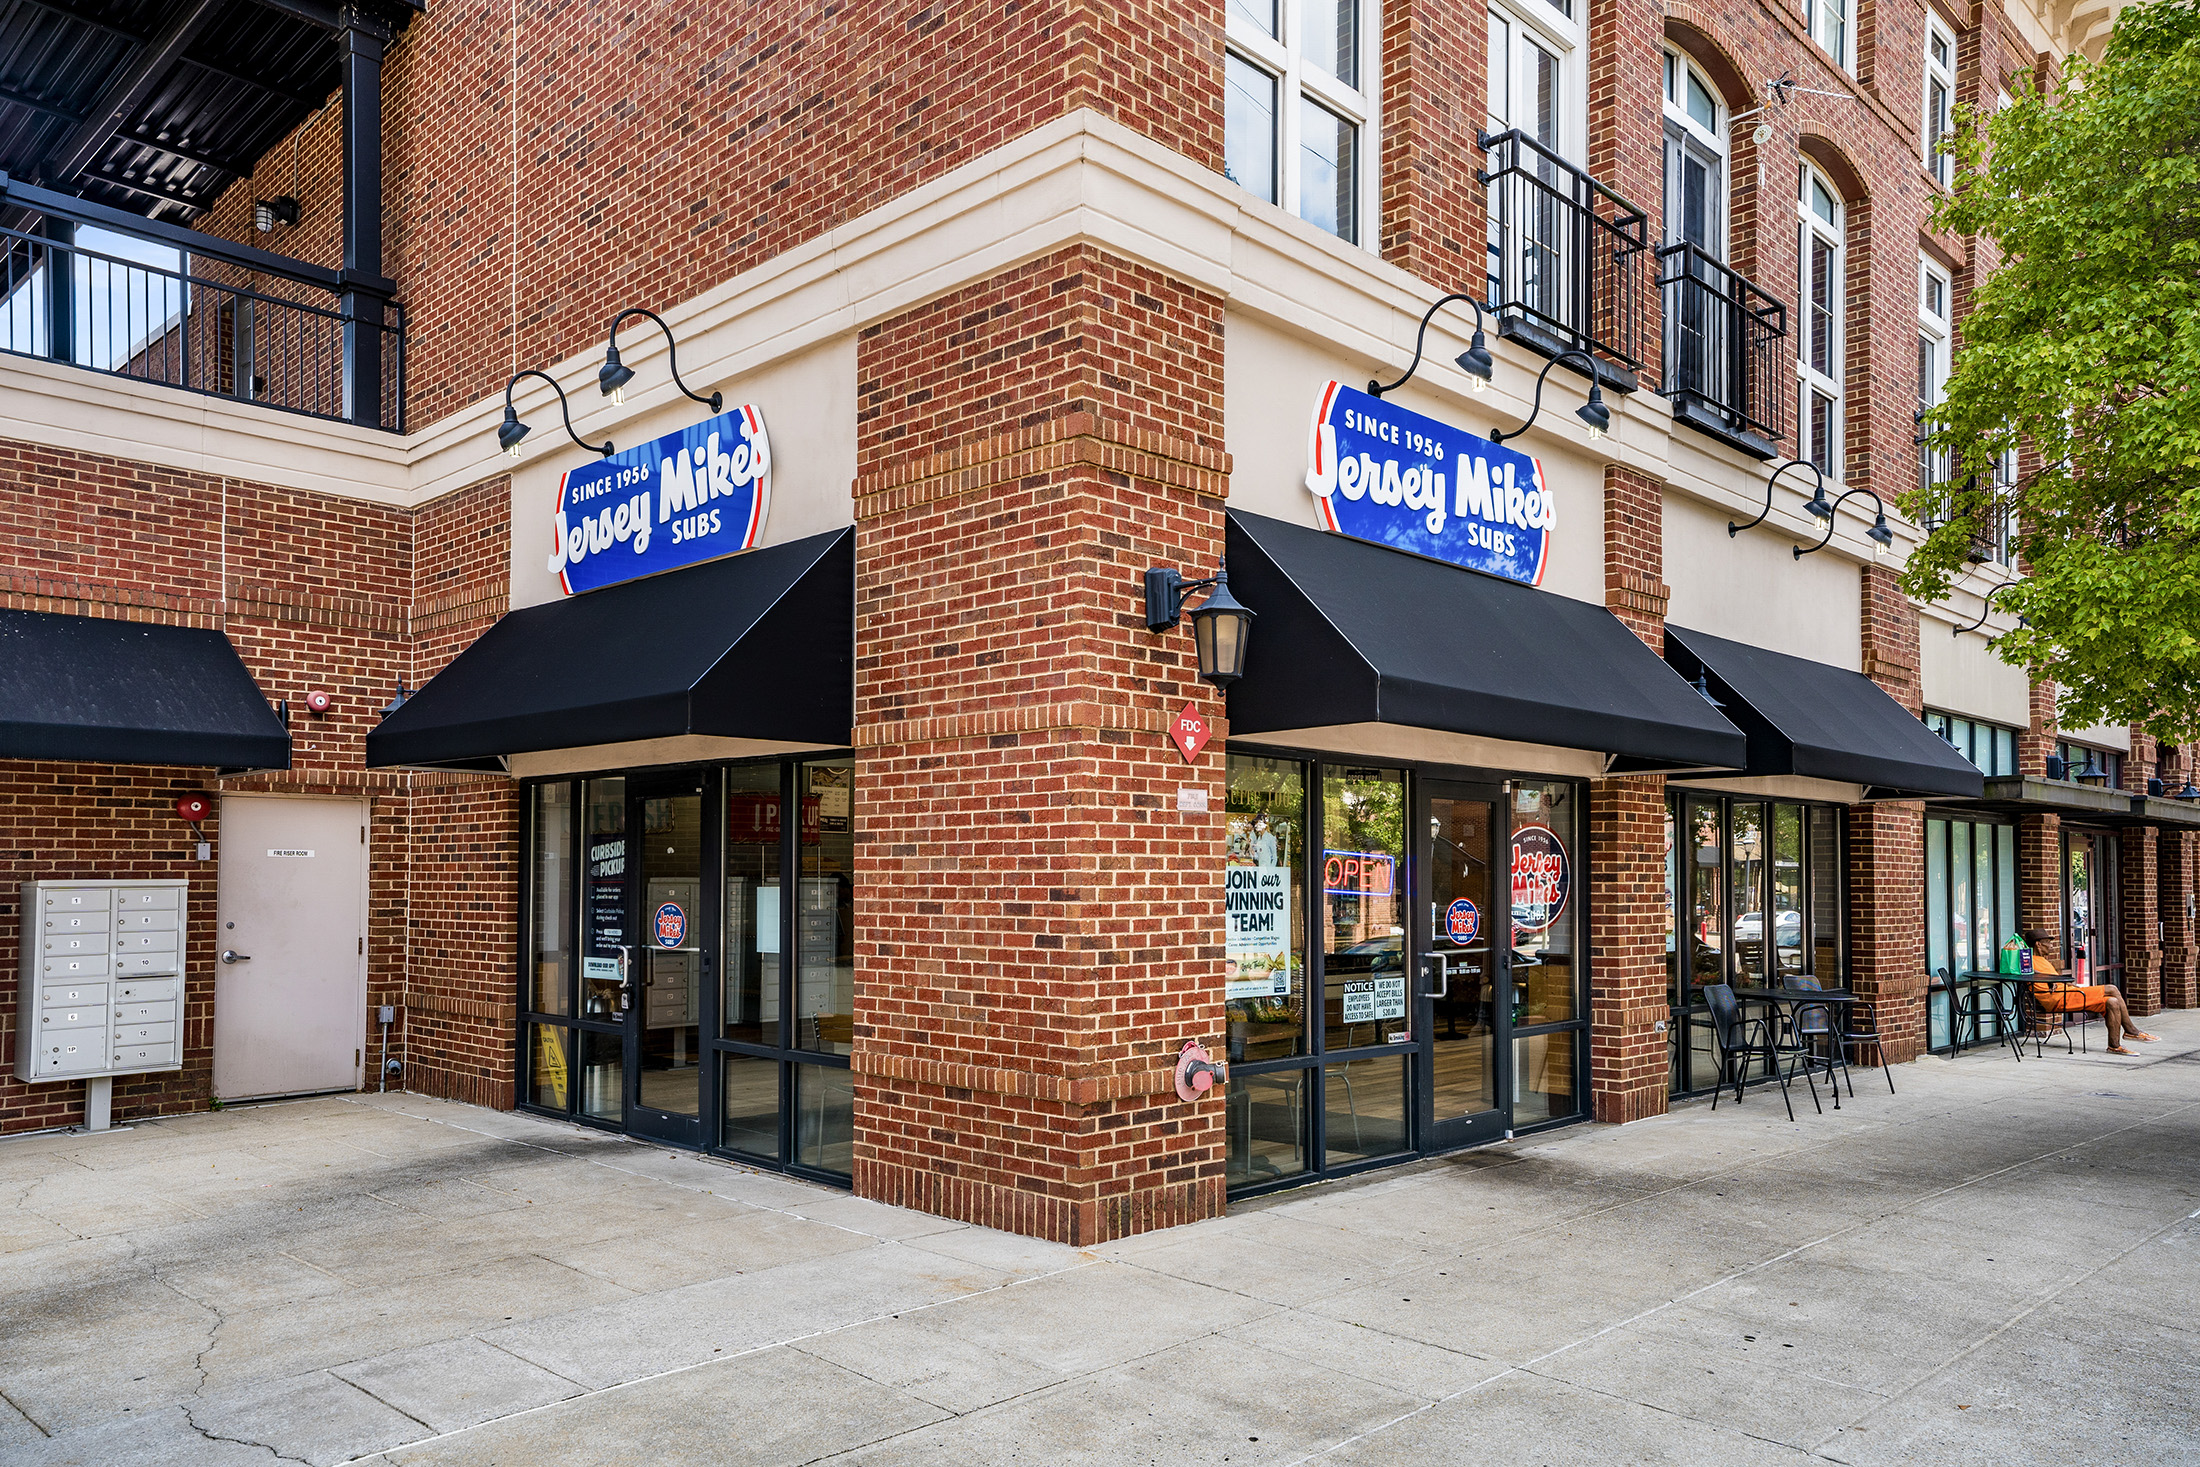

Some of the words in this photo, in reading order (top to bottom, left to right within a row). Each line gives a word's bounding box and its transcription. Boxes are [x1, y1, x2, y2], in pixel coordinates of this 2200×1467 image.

[1345, 409, 1399, 445] SINCE
[1405, 430, 1444, 460] 1956
[572, 475, 612, 504] SINCE
[616, 463, 649, 490] 1956
[1305, 423, 1447, 534] Jersey
[1455, 453, 1557, 532] Mike's
[547, 491, 652, 574] Jersey
[659, 421, 770, 524] Mike's
[672, 509, 721, 544] SUBS
[1468, 522, 1516, 557] SUBS
[1180, 719, 1201, 733] FDC
[1523, 835, 1537, 843] SINCE
[1538, 835, 1549, 844] 1956
[591, 840, 625, 862] CURBSIDE
[1511, 843, 1562, 883] Jersey
[1226, 870, 1257, 889] JOIN
[1261, 874, 1281, 887] our
[1324, 857, 1391, 889] OPEN
[1511, 874, 1561, 905] Mike's
[658, 910, 682, 929] Jersey
[1232, 912, 1274, 932] TEAM!
[1450, 906, 1475, 924] Jersey
[1525, 909, 1546, 921] SUBS
[1344, 982, 1374, 993] NOTICE
[1376, 990, 1391, 999] ACCEPT
[1391, 989, 1403, 998] BILLS
[1378, 981, 1387, 989] WE
[1386, 981, 1392, 989] DO
[1391, 980, 1401, 988] NOT
[1346, 1004, 1353, 1012] DO
[1353, 1003, 1361, 1011] NOT
[1361, 1002, 1372, 1010] HAVE
[1347, 994, 1370, 1003] EMPLOYEES
[1376, 999, 1393, 1008] LARGER
[1392, 998, 1403, 1006] THAN
[1344, 1012, 1359, 1020] ACCESS
[1358, 1011, 1364, 1019] TO
[1363, 1010, 1374, 1019] SAFE
[1382, 1008, 1397, 1017] $20.00
